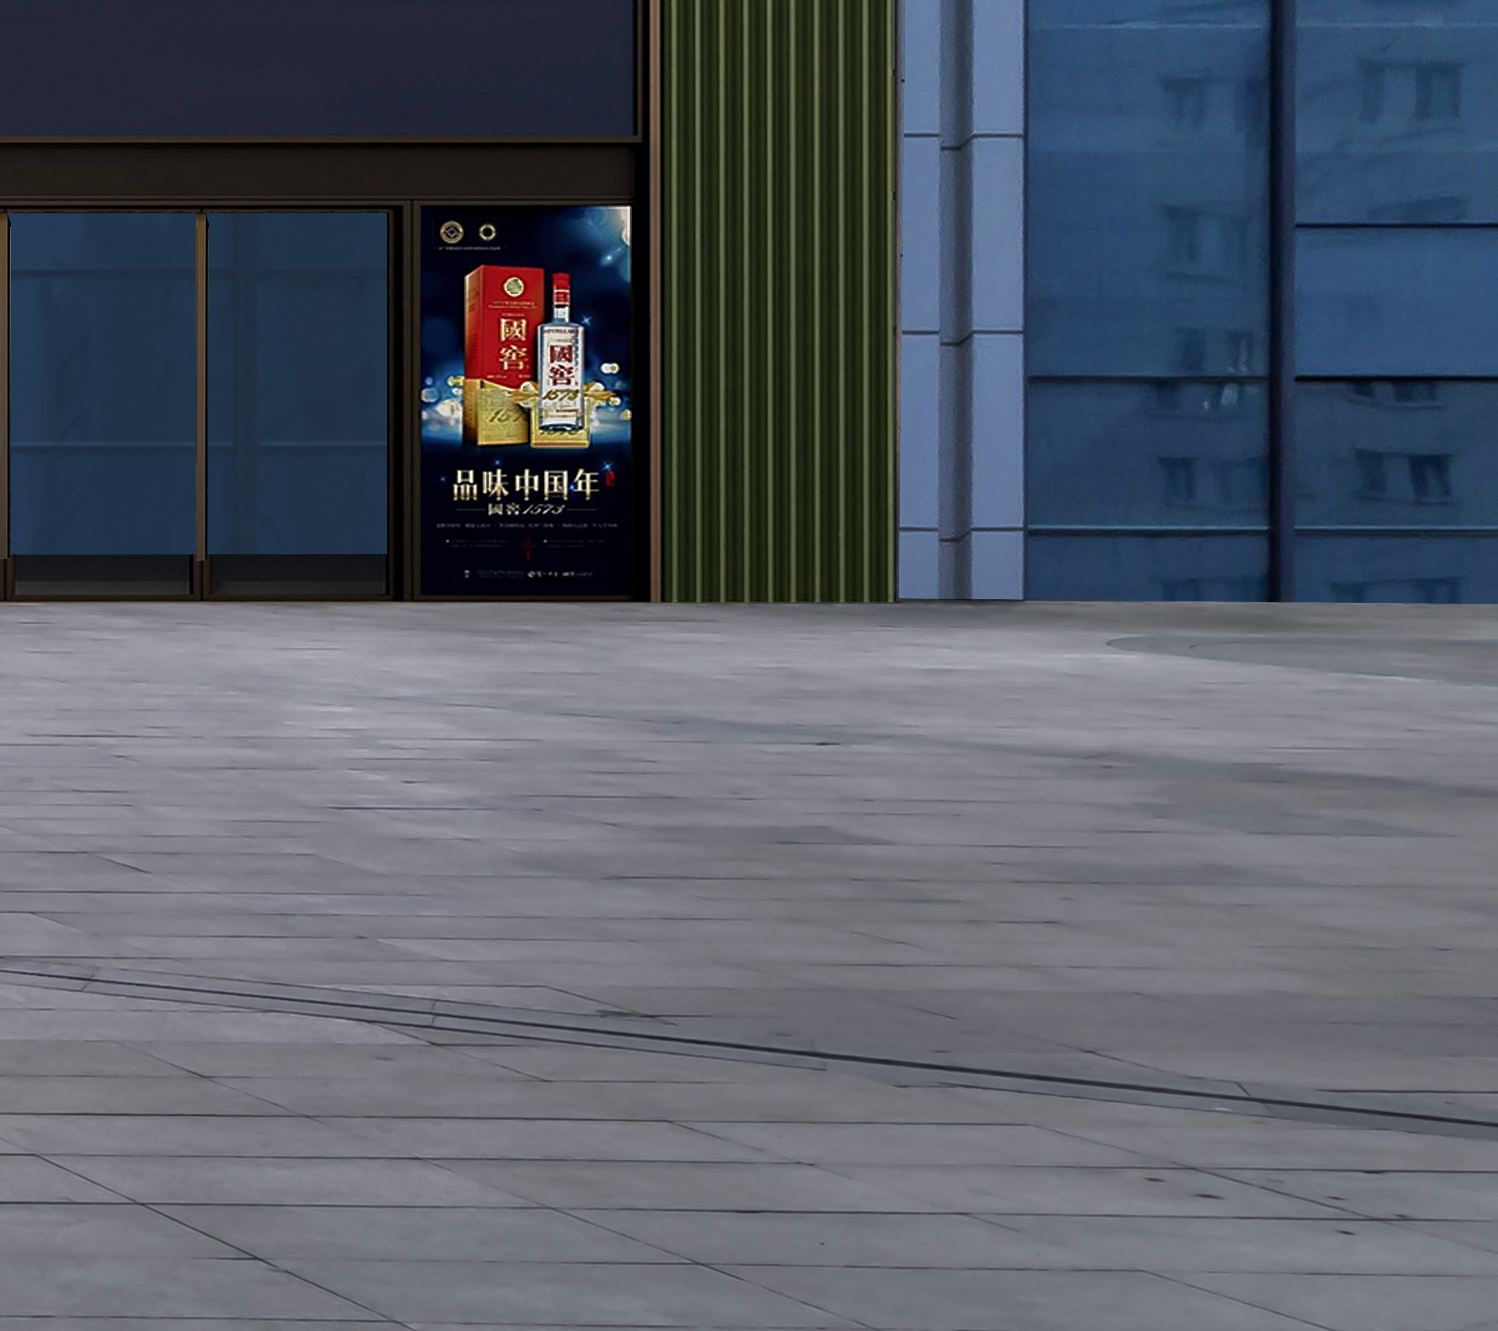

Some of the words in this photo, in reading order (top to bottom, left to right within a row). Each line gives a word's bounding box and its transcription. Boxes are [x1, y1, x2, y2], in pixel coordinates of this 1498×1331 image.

[452, 468, 600, 501] 品味中国年
